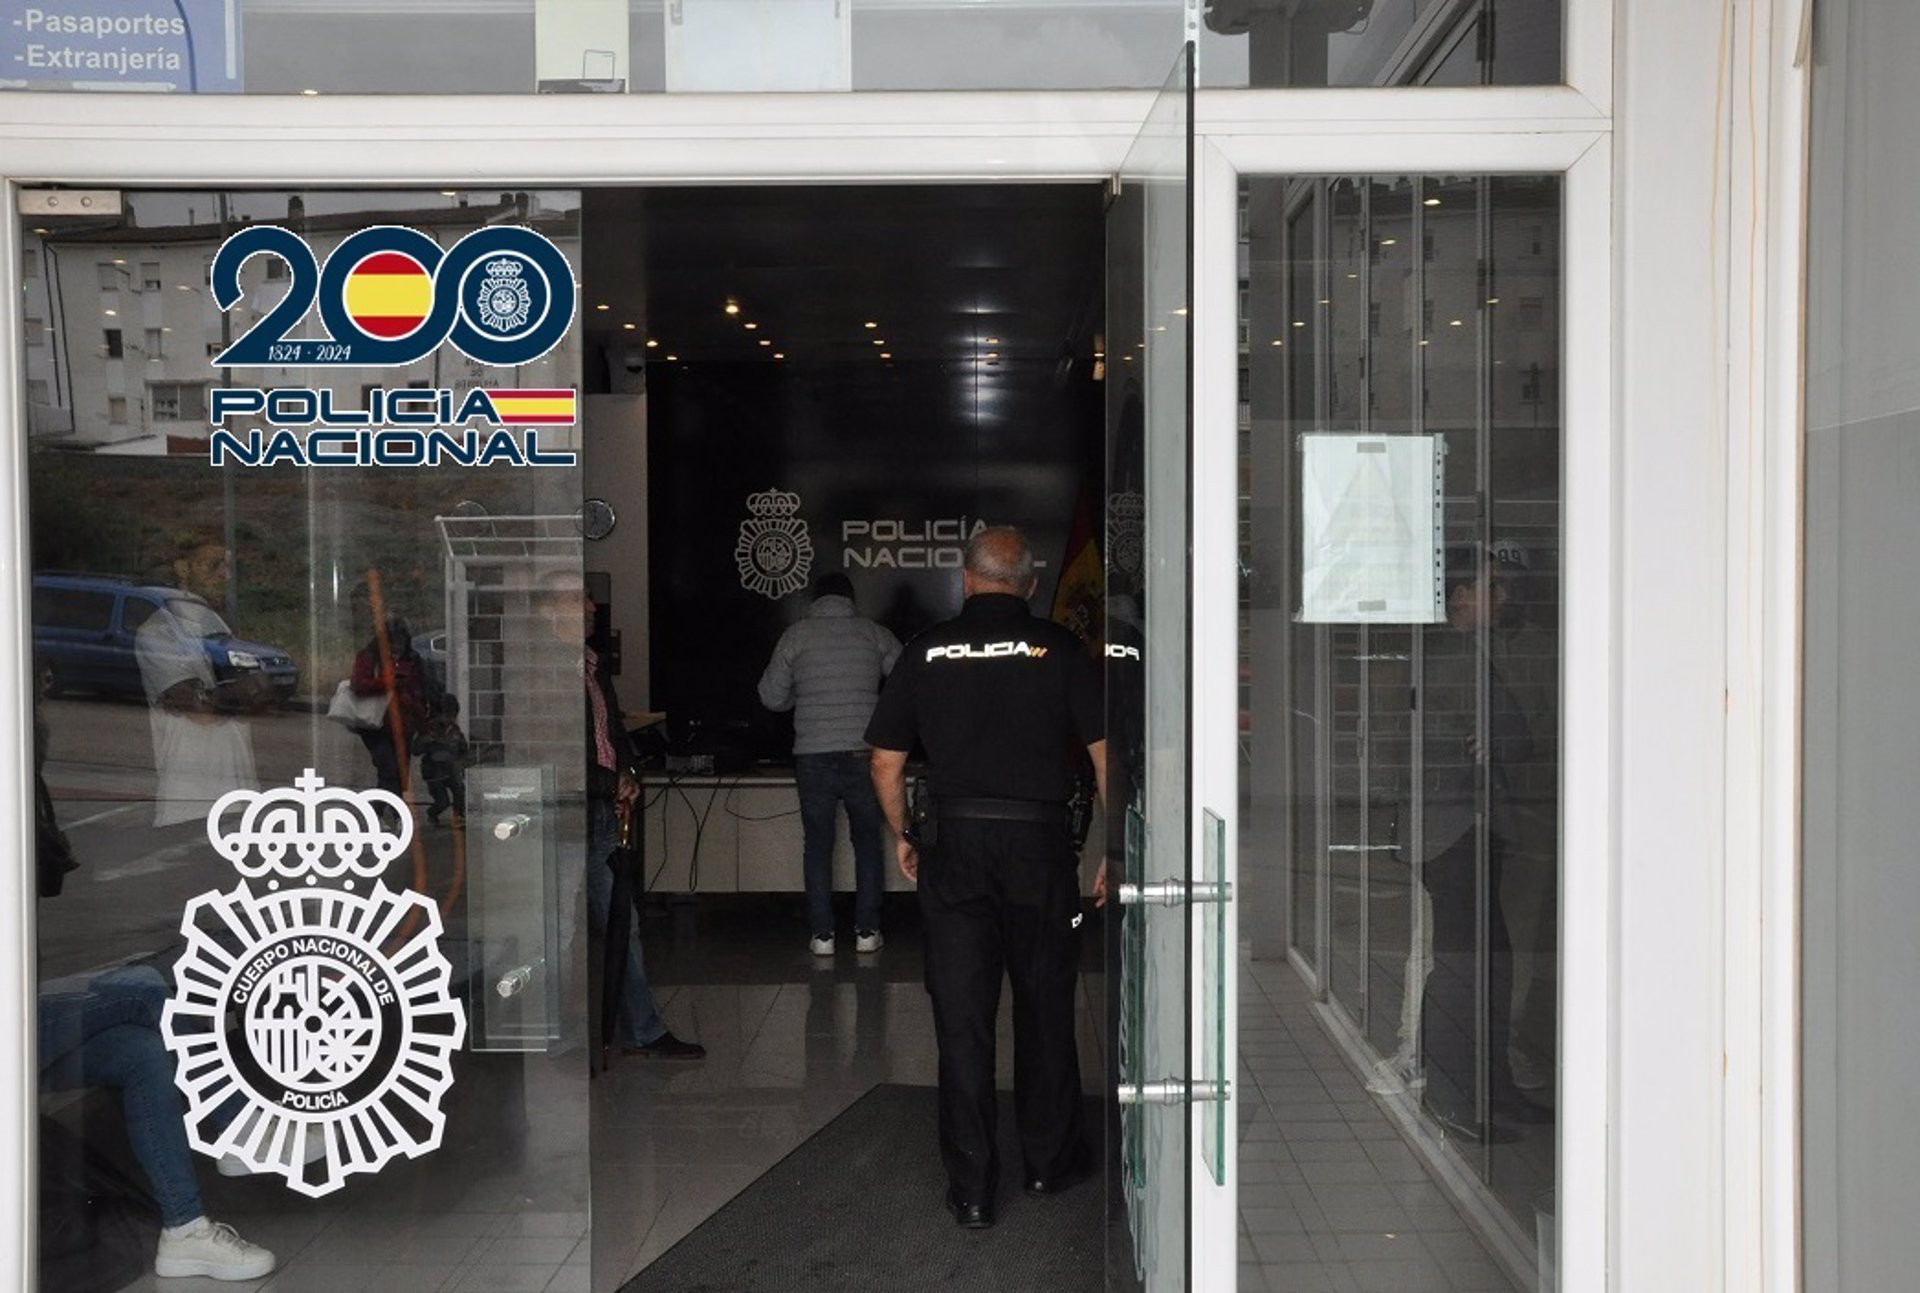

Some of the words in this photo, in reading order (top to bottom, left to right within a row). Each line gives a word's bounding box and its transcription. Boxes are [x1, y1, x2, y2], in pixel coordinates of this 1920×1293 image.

[13, 9, 186, 39] -Pasaportes
[14, 44, 181, 75] -Extranjería
[843, 546, 1047, 569] NACIO
[232, 944, 290, 1004] CUERPO
[292, 938, 378, 983] NACIONAL
[374, 979, 395, 1007] DE
